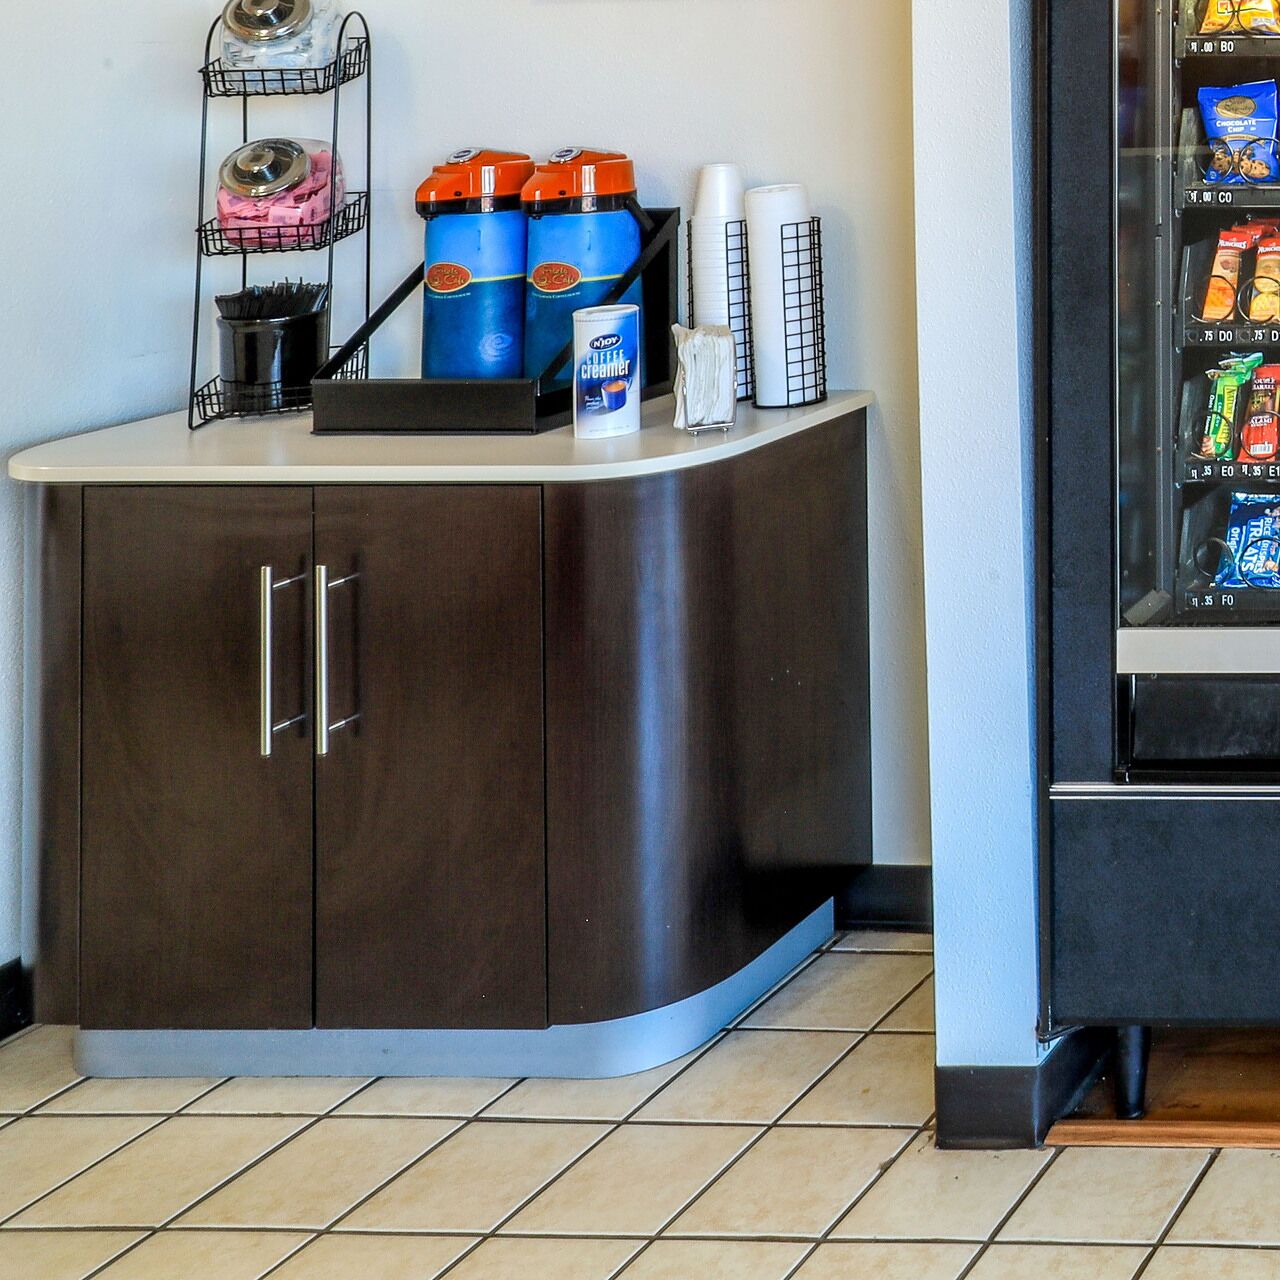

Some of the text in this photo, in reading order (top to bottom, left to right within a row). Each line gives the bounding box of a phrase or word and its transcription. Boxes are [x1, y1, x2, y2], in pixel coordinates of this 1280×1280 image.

[1220, 41, 1234, 52] B0
[1216, 119, 1257, 127] CHOCOLATE
[1218, 191, 1232, 203] C0
[1200, 330, 1213, 342] .75
[1251, 329, 1263, 342] .75
[586, 349, 625, 365] COFFEE
[581, 359, 631, 379] creamer
[1221, 466, 1233, 477] E0
[1269, 466, 1280, 476] E1
[1263, 517, 1273, 536] RICE
[1221, 595, 1234, 606] F0
